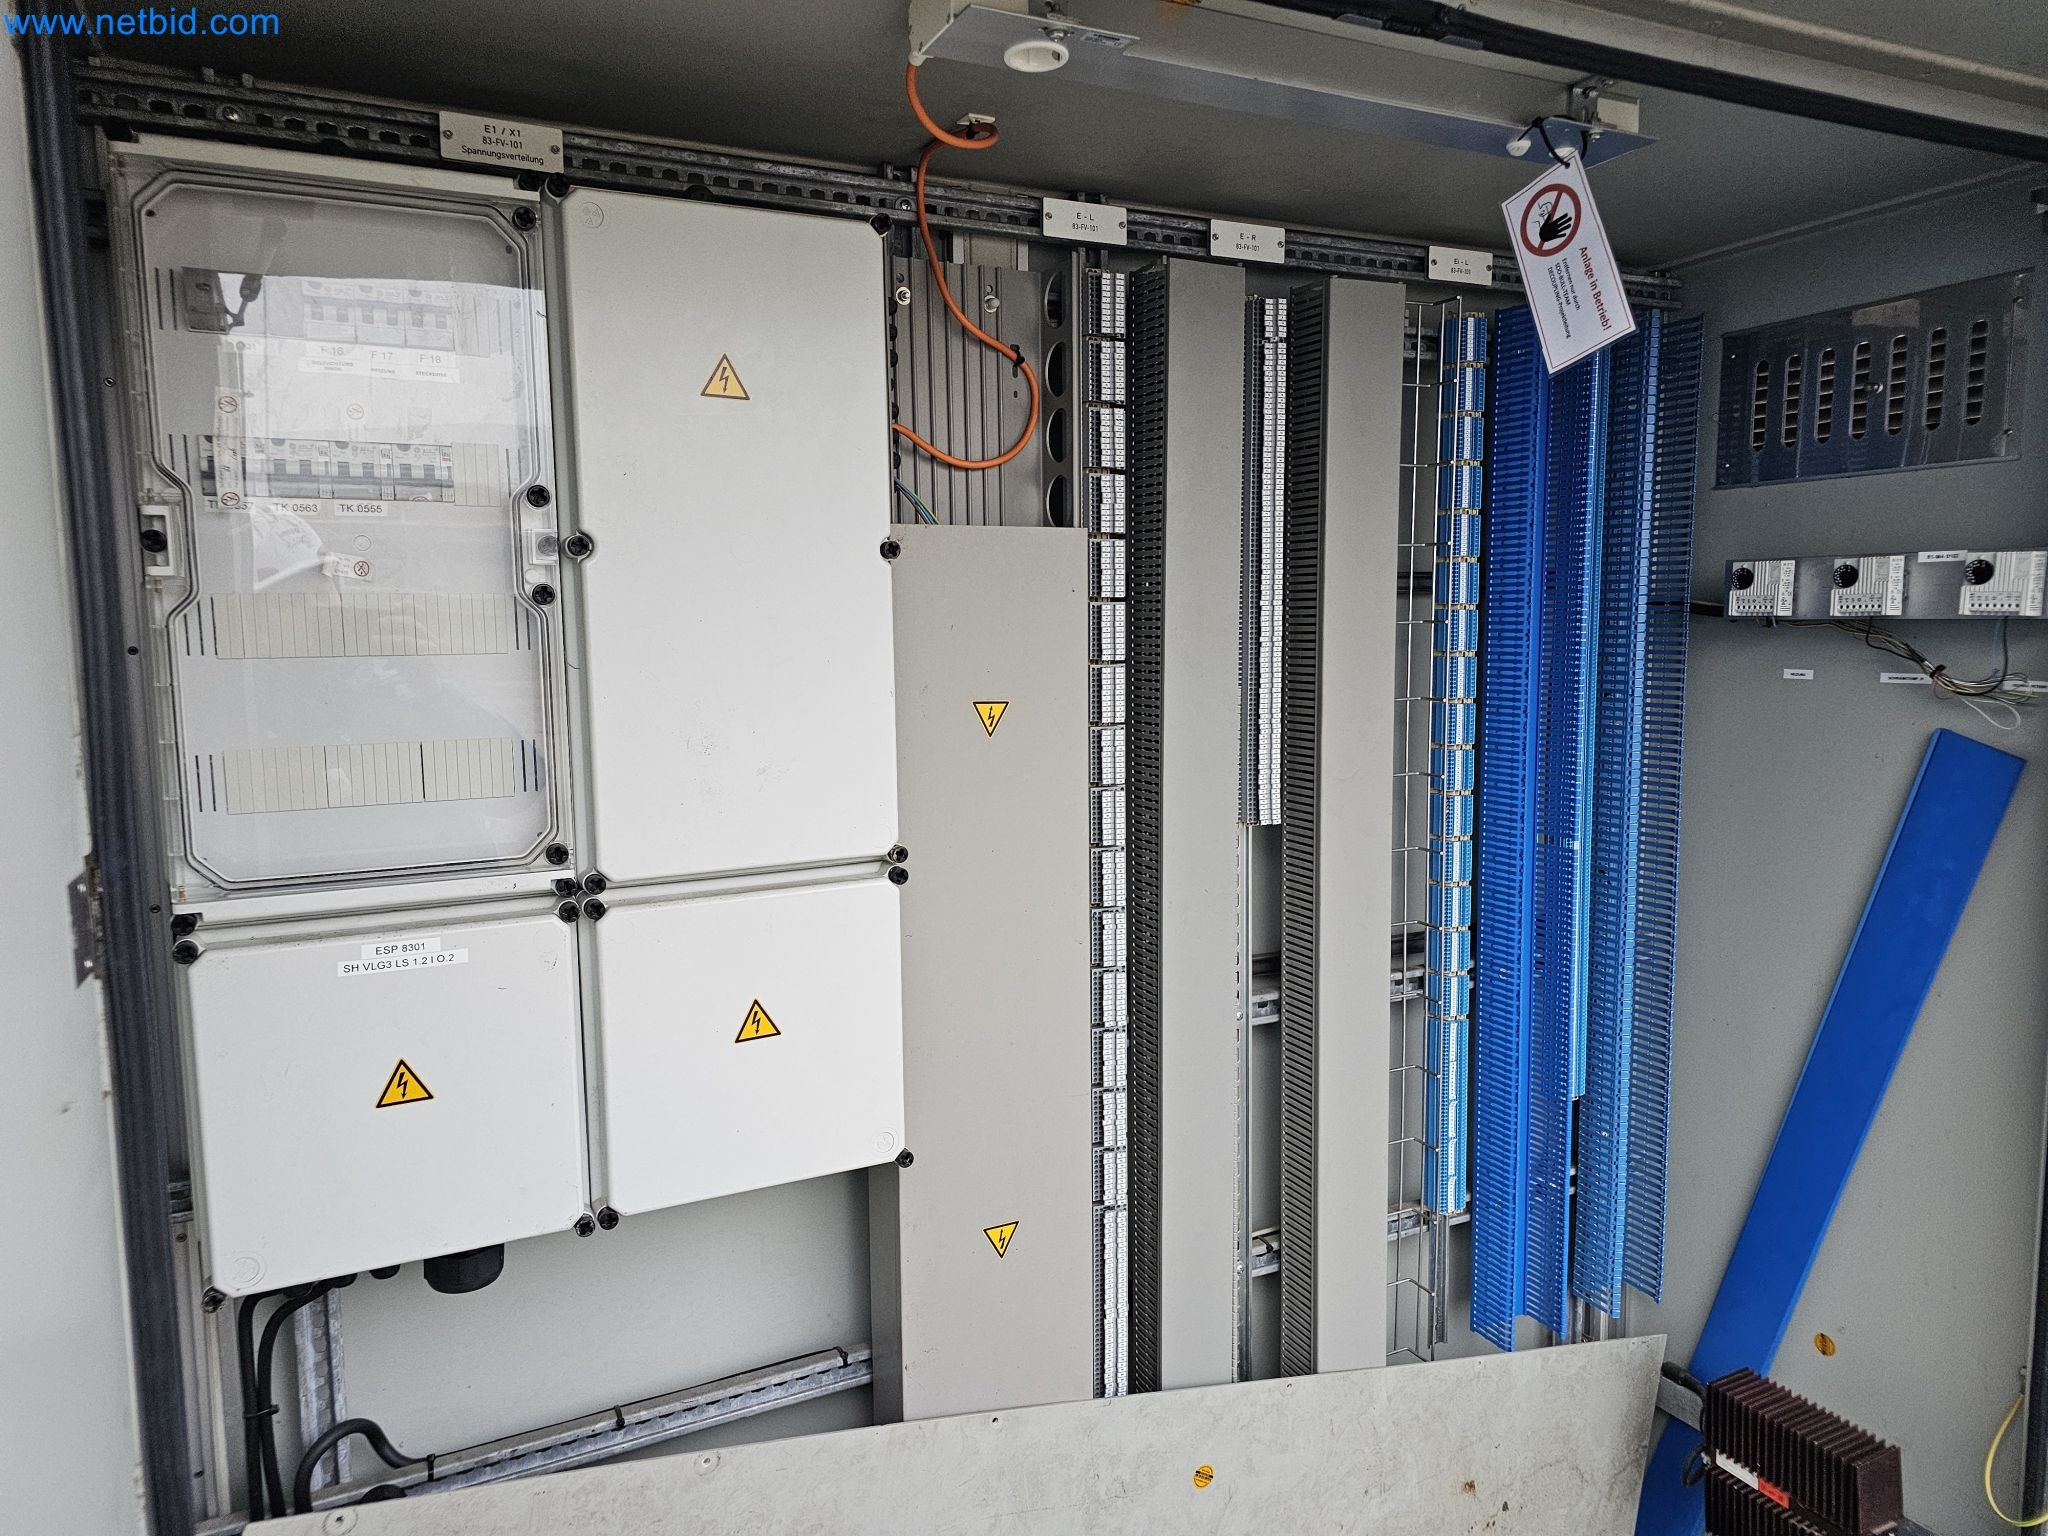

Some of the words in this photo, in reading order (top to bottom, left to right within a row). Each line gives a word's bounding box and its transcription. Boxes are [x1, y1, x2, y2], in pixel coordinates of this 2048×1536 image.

[484, 124, 497, 134] E1
[509, 128, 521, 138] X1
[482, 136, 523, 150] 83-FV-101
[461, 145, 544, 166] Spannungsverteilung
[1076, 212, 1082, 220] E
[1089, 213, 1095, 221] L
[1239, 232, 1245, 240] E
[1579, 246, 1594, 279] Anlage
[1562, 257, 1573, 284] Entfernen
[1572, 295, 1581, 311] durch
[1589, 279, 1598, 291] in
[1593, 291, 1612, 331] Betrieb!
[381, 351, 393, 361] 17
[430, 354, 442, 365] 18
[275, 502, 289, 512] TK
[292, 503, 318, 513] 0563
[339, 504, 354, 513] TK
[357, 504, 383, 514] 0555
[375, 945, 398, 955] ESP
[401, 942, 425, 953] 8301
[343, 964, 359, 974] SH
[362, 960, 392, 972] VLG3
[395, 958, 409, 968] LS
[412, 956, 428, 966] 1.2
